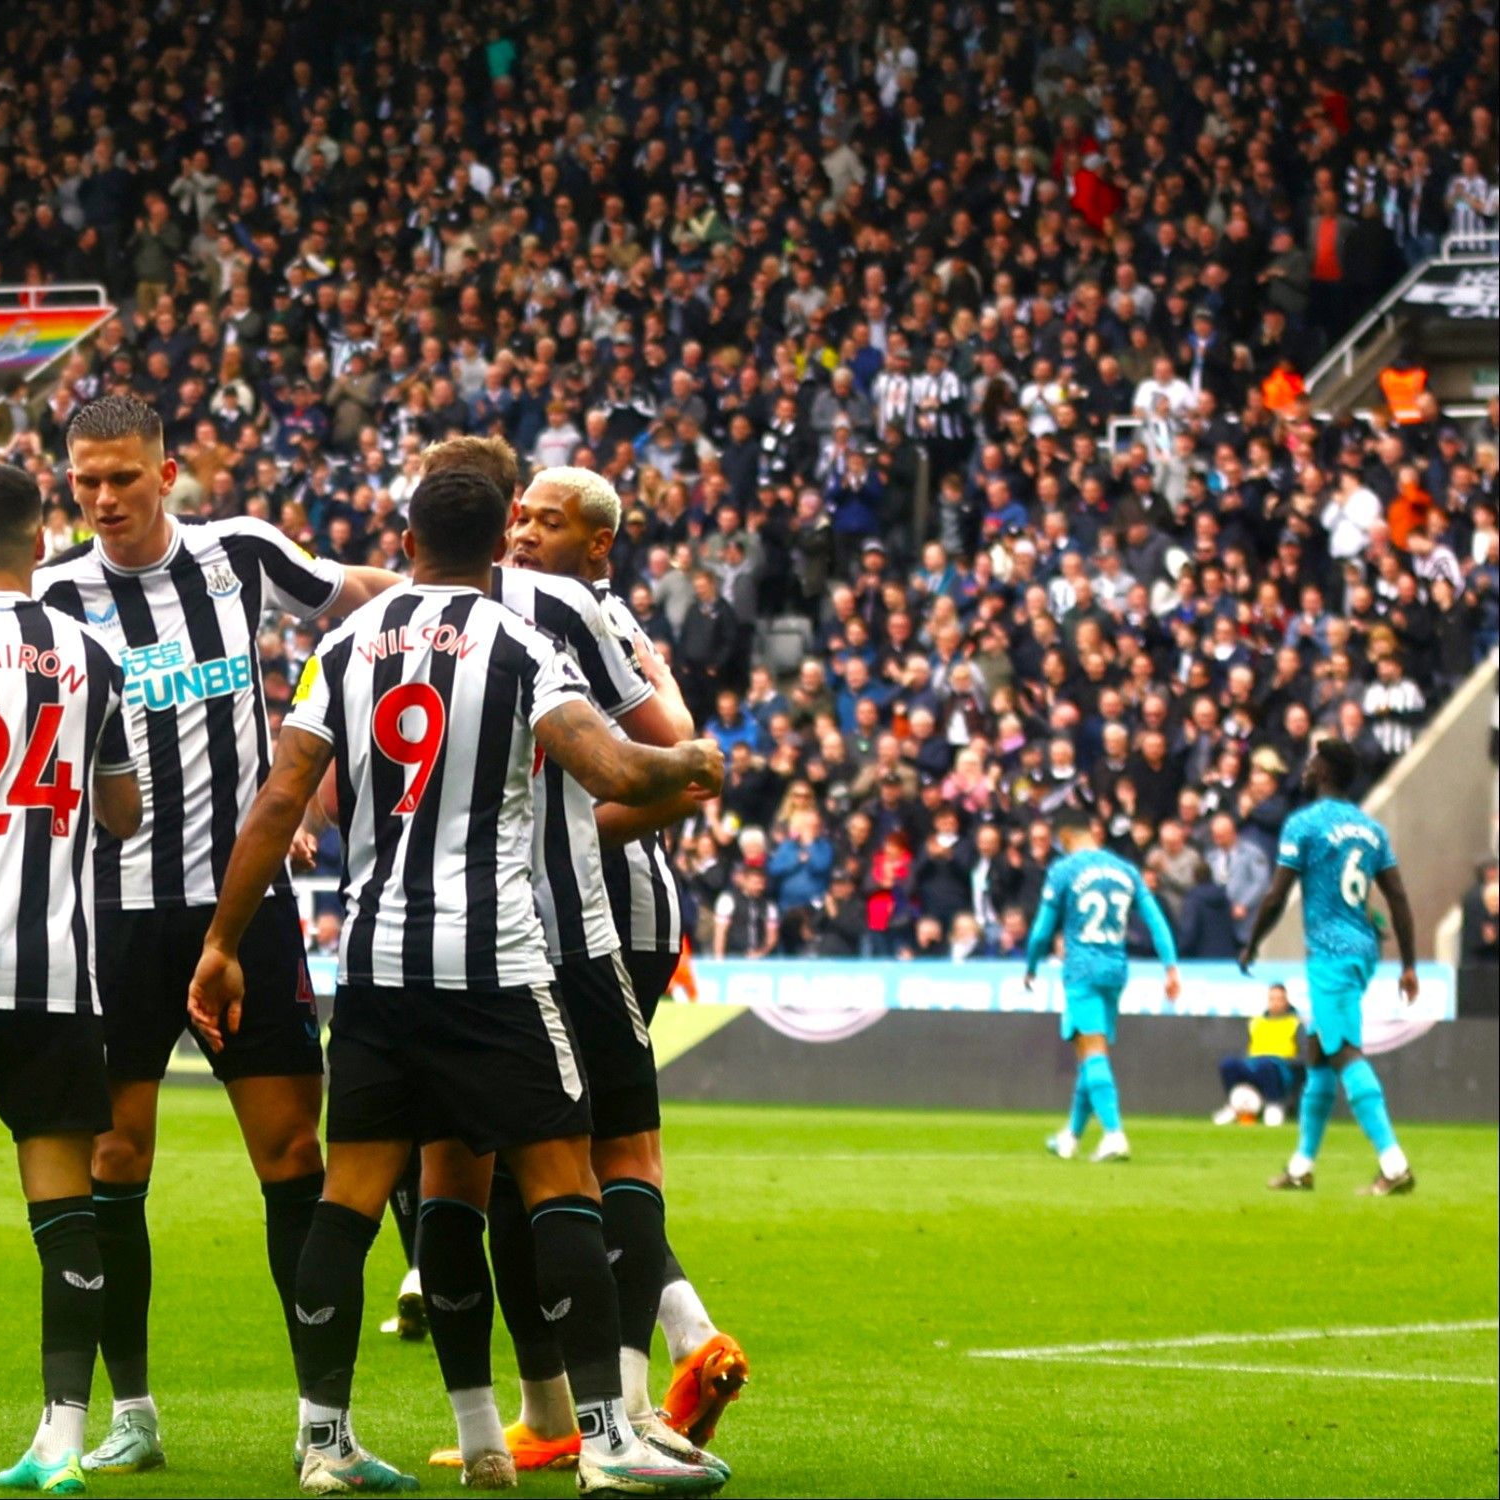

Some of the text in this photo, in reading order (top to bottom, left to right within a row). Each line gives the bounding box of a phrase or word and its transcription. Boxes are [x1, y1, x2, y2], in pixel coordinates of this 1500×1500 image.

[356, 623, 479, 665] WILSON
[371, 682, 446, 816] 9
[1341, 847, 1367, 909] 6
[1077, 889, 1133, 945] 23
